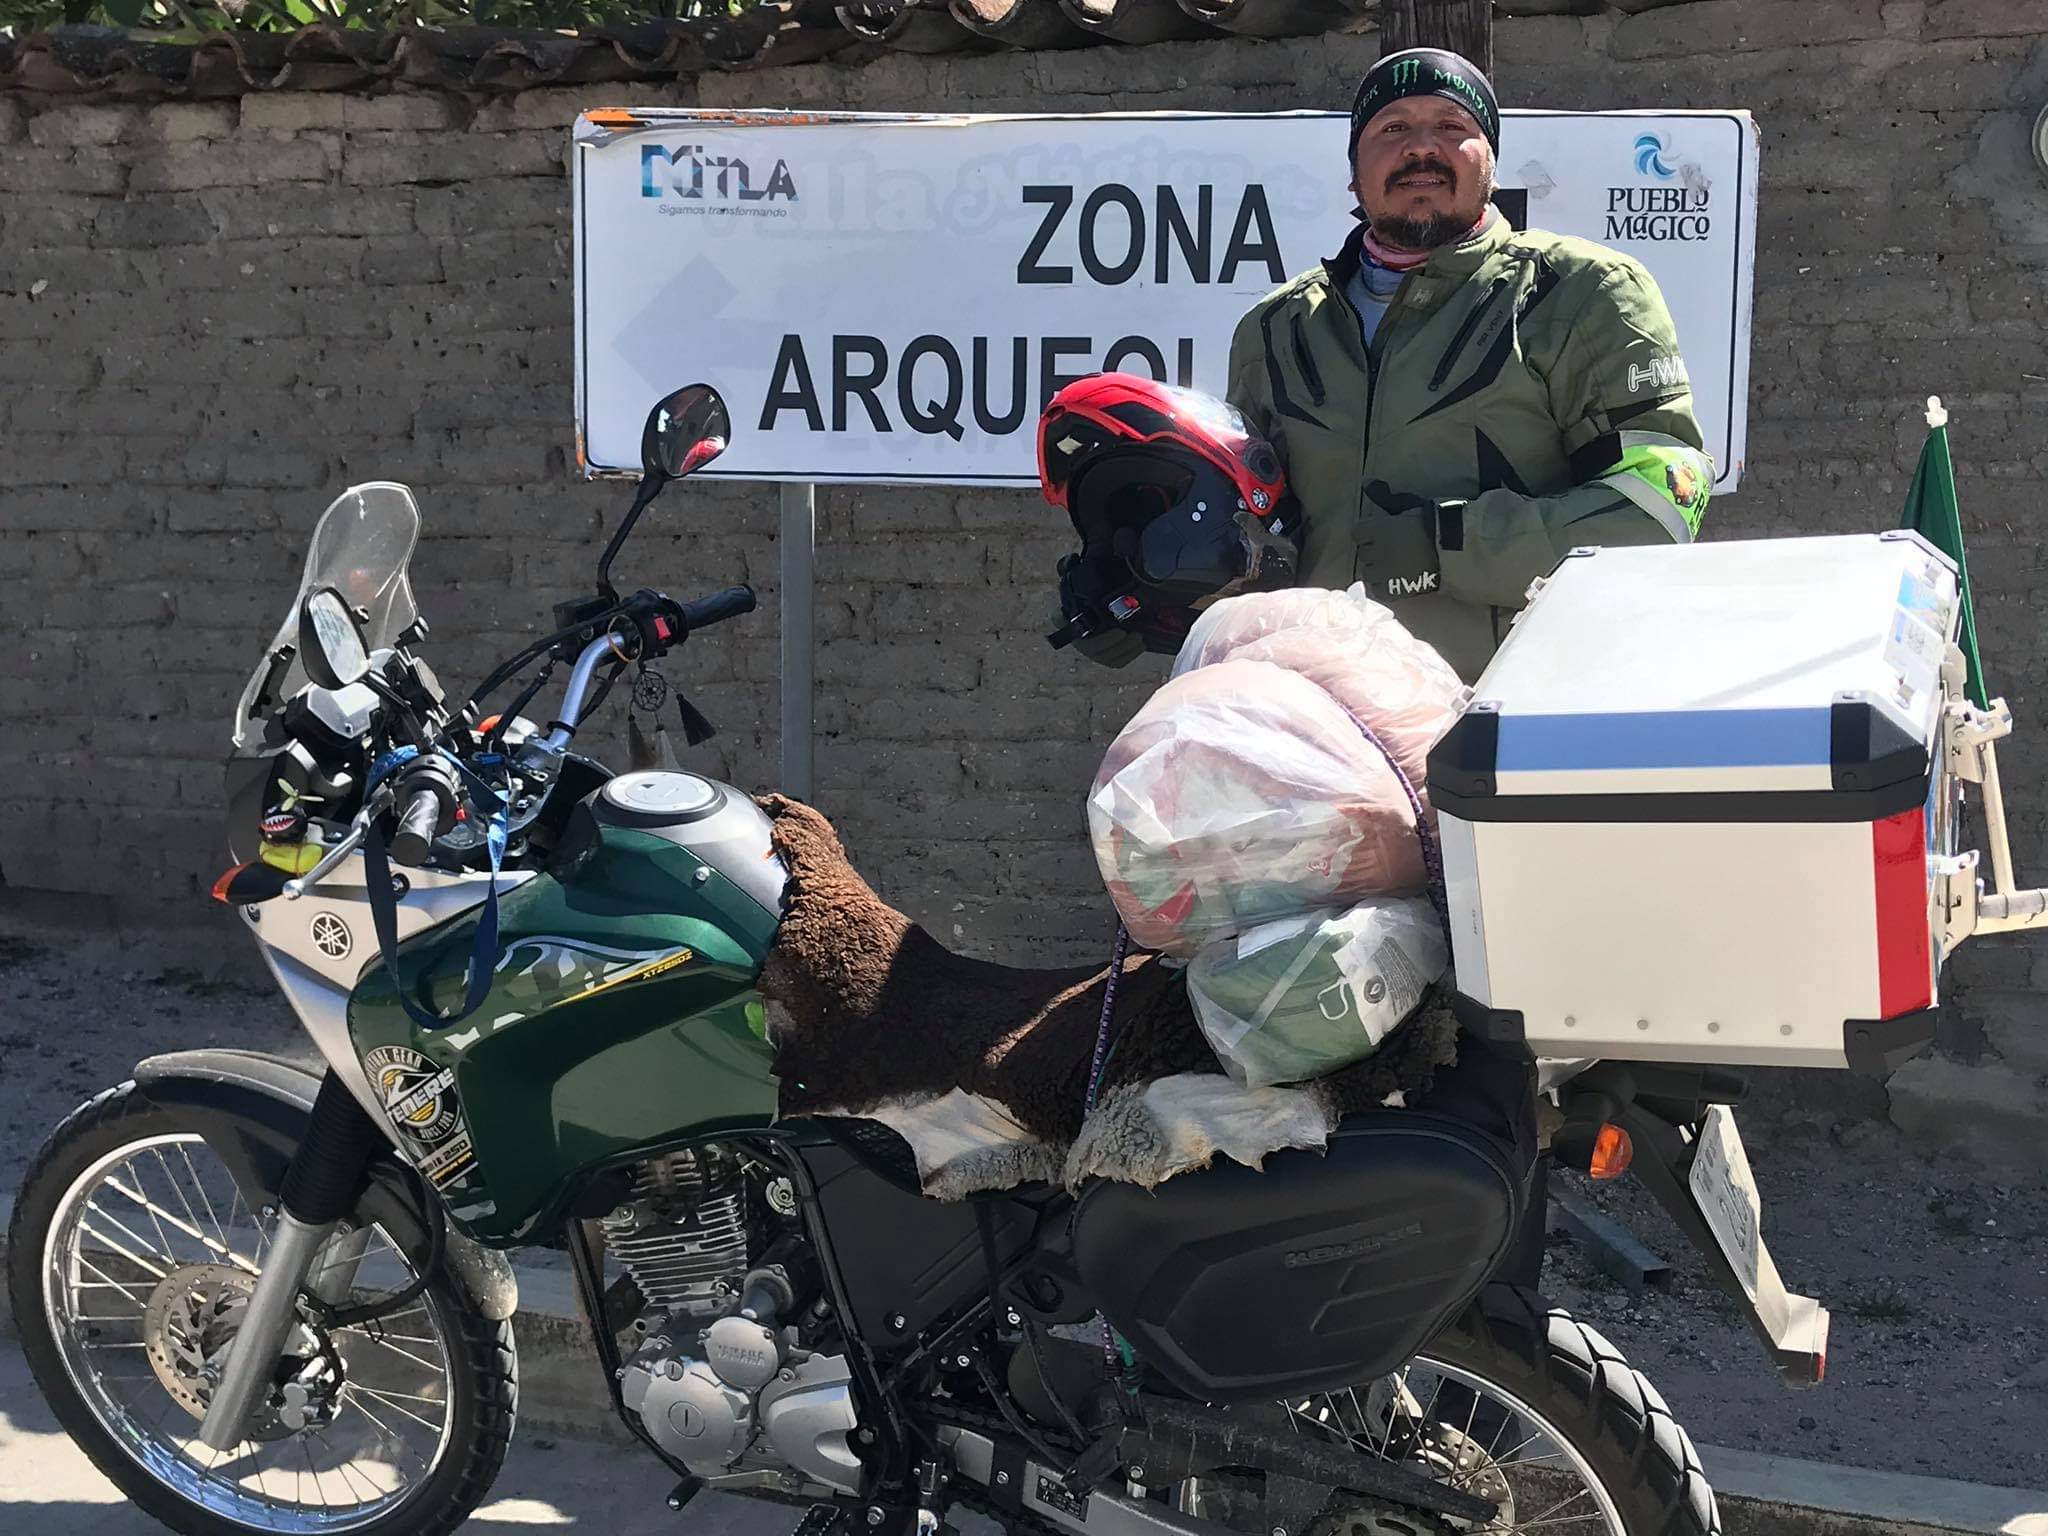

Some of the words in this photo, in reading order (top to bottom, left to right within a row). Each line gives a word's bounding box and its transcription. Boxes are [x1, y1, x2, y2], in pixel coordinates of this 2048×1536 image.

[658, 204, 706, 217] Sigamos
[708, 205, 788, 218] transformando
[1017, 183, 1287, 285] ZONA
[1388, 571, 1438, 595] HWK
[443, 1139, 468, 1161] 250
